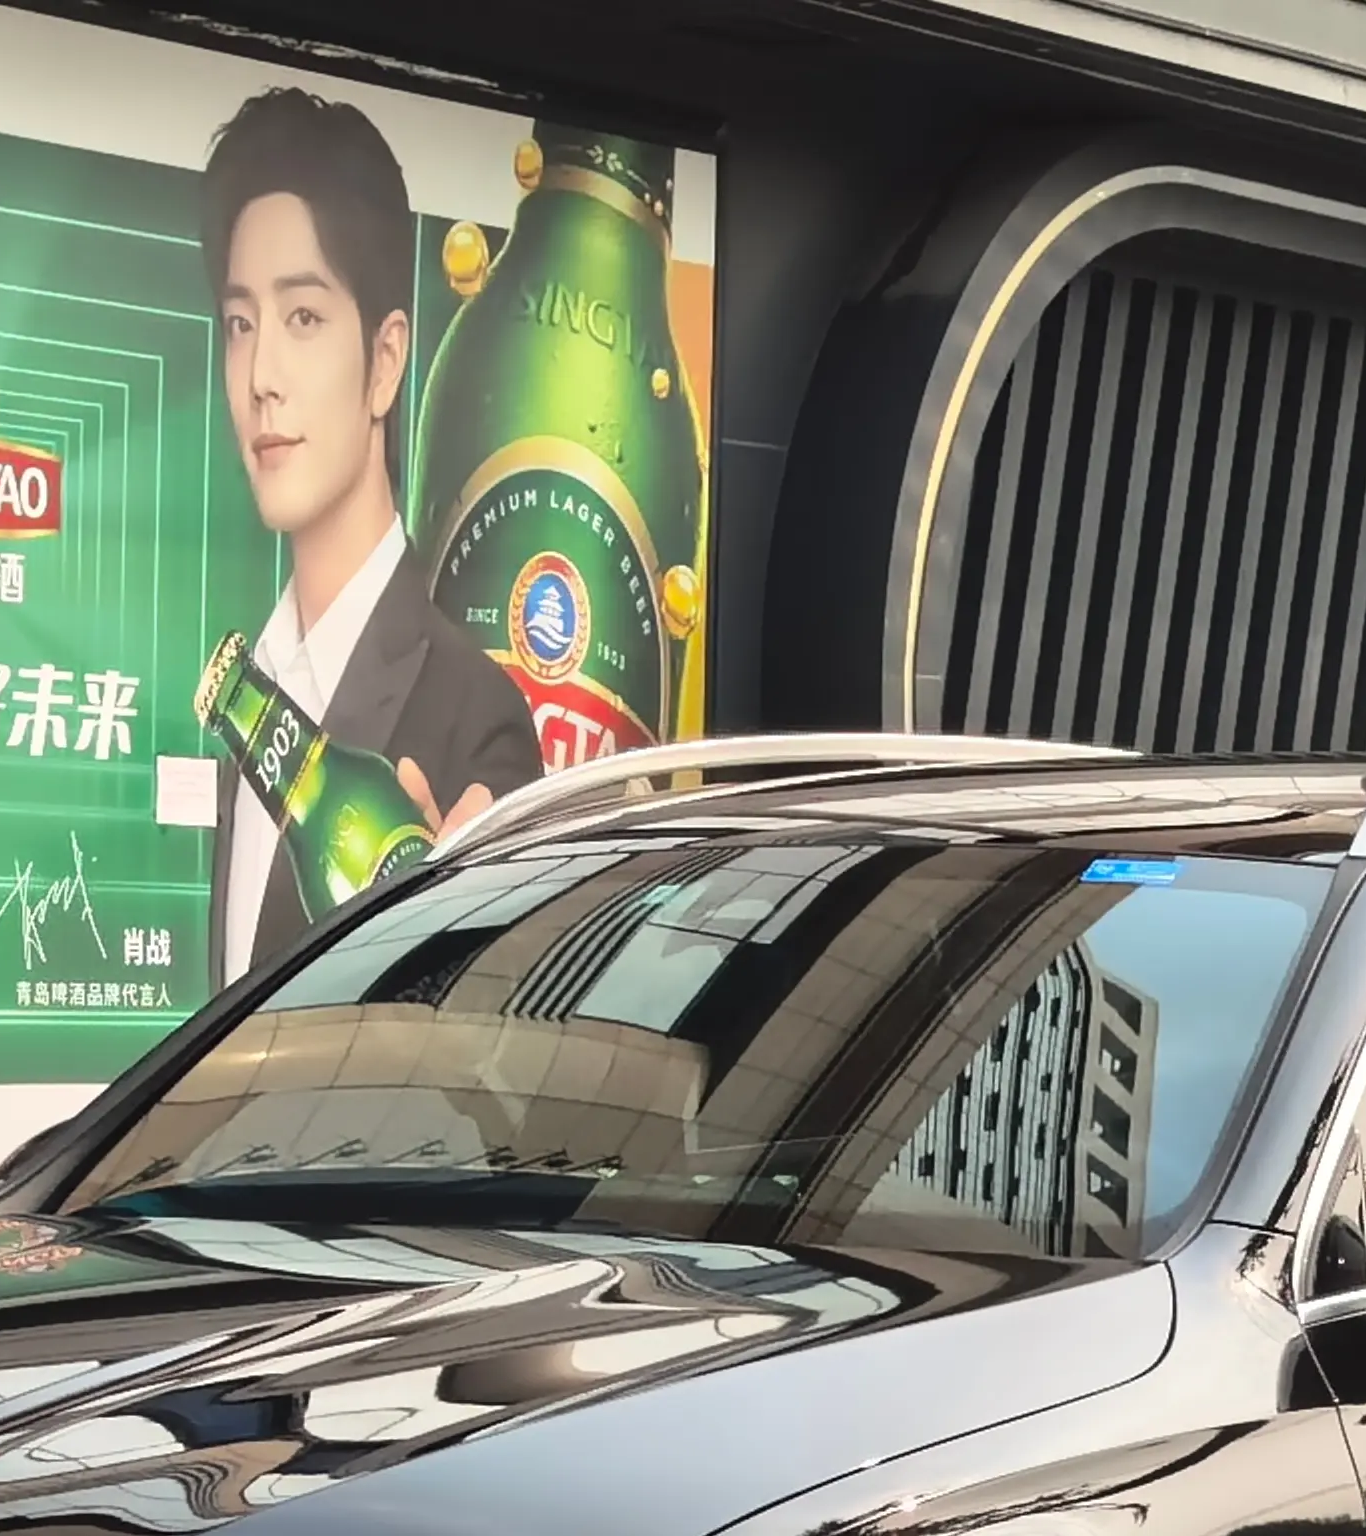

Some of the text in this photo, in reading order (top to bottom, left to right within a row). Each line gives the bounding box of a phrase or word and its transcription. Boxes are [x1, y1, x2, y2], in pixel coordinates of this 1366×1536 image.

[450, 488, 538, 576] PREMIUM
[550, 490, 616, 548] LAGER
[465, 606, 500, 625] SINCE
[596, 641, 627, 671] 1903
[254, 706, 303, 794] 1903
[123, 927, 172, 966] 肖战
[16, 981, 172, 1007] 青岛啤酒品牌代言人
